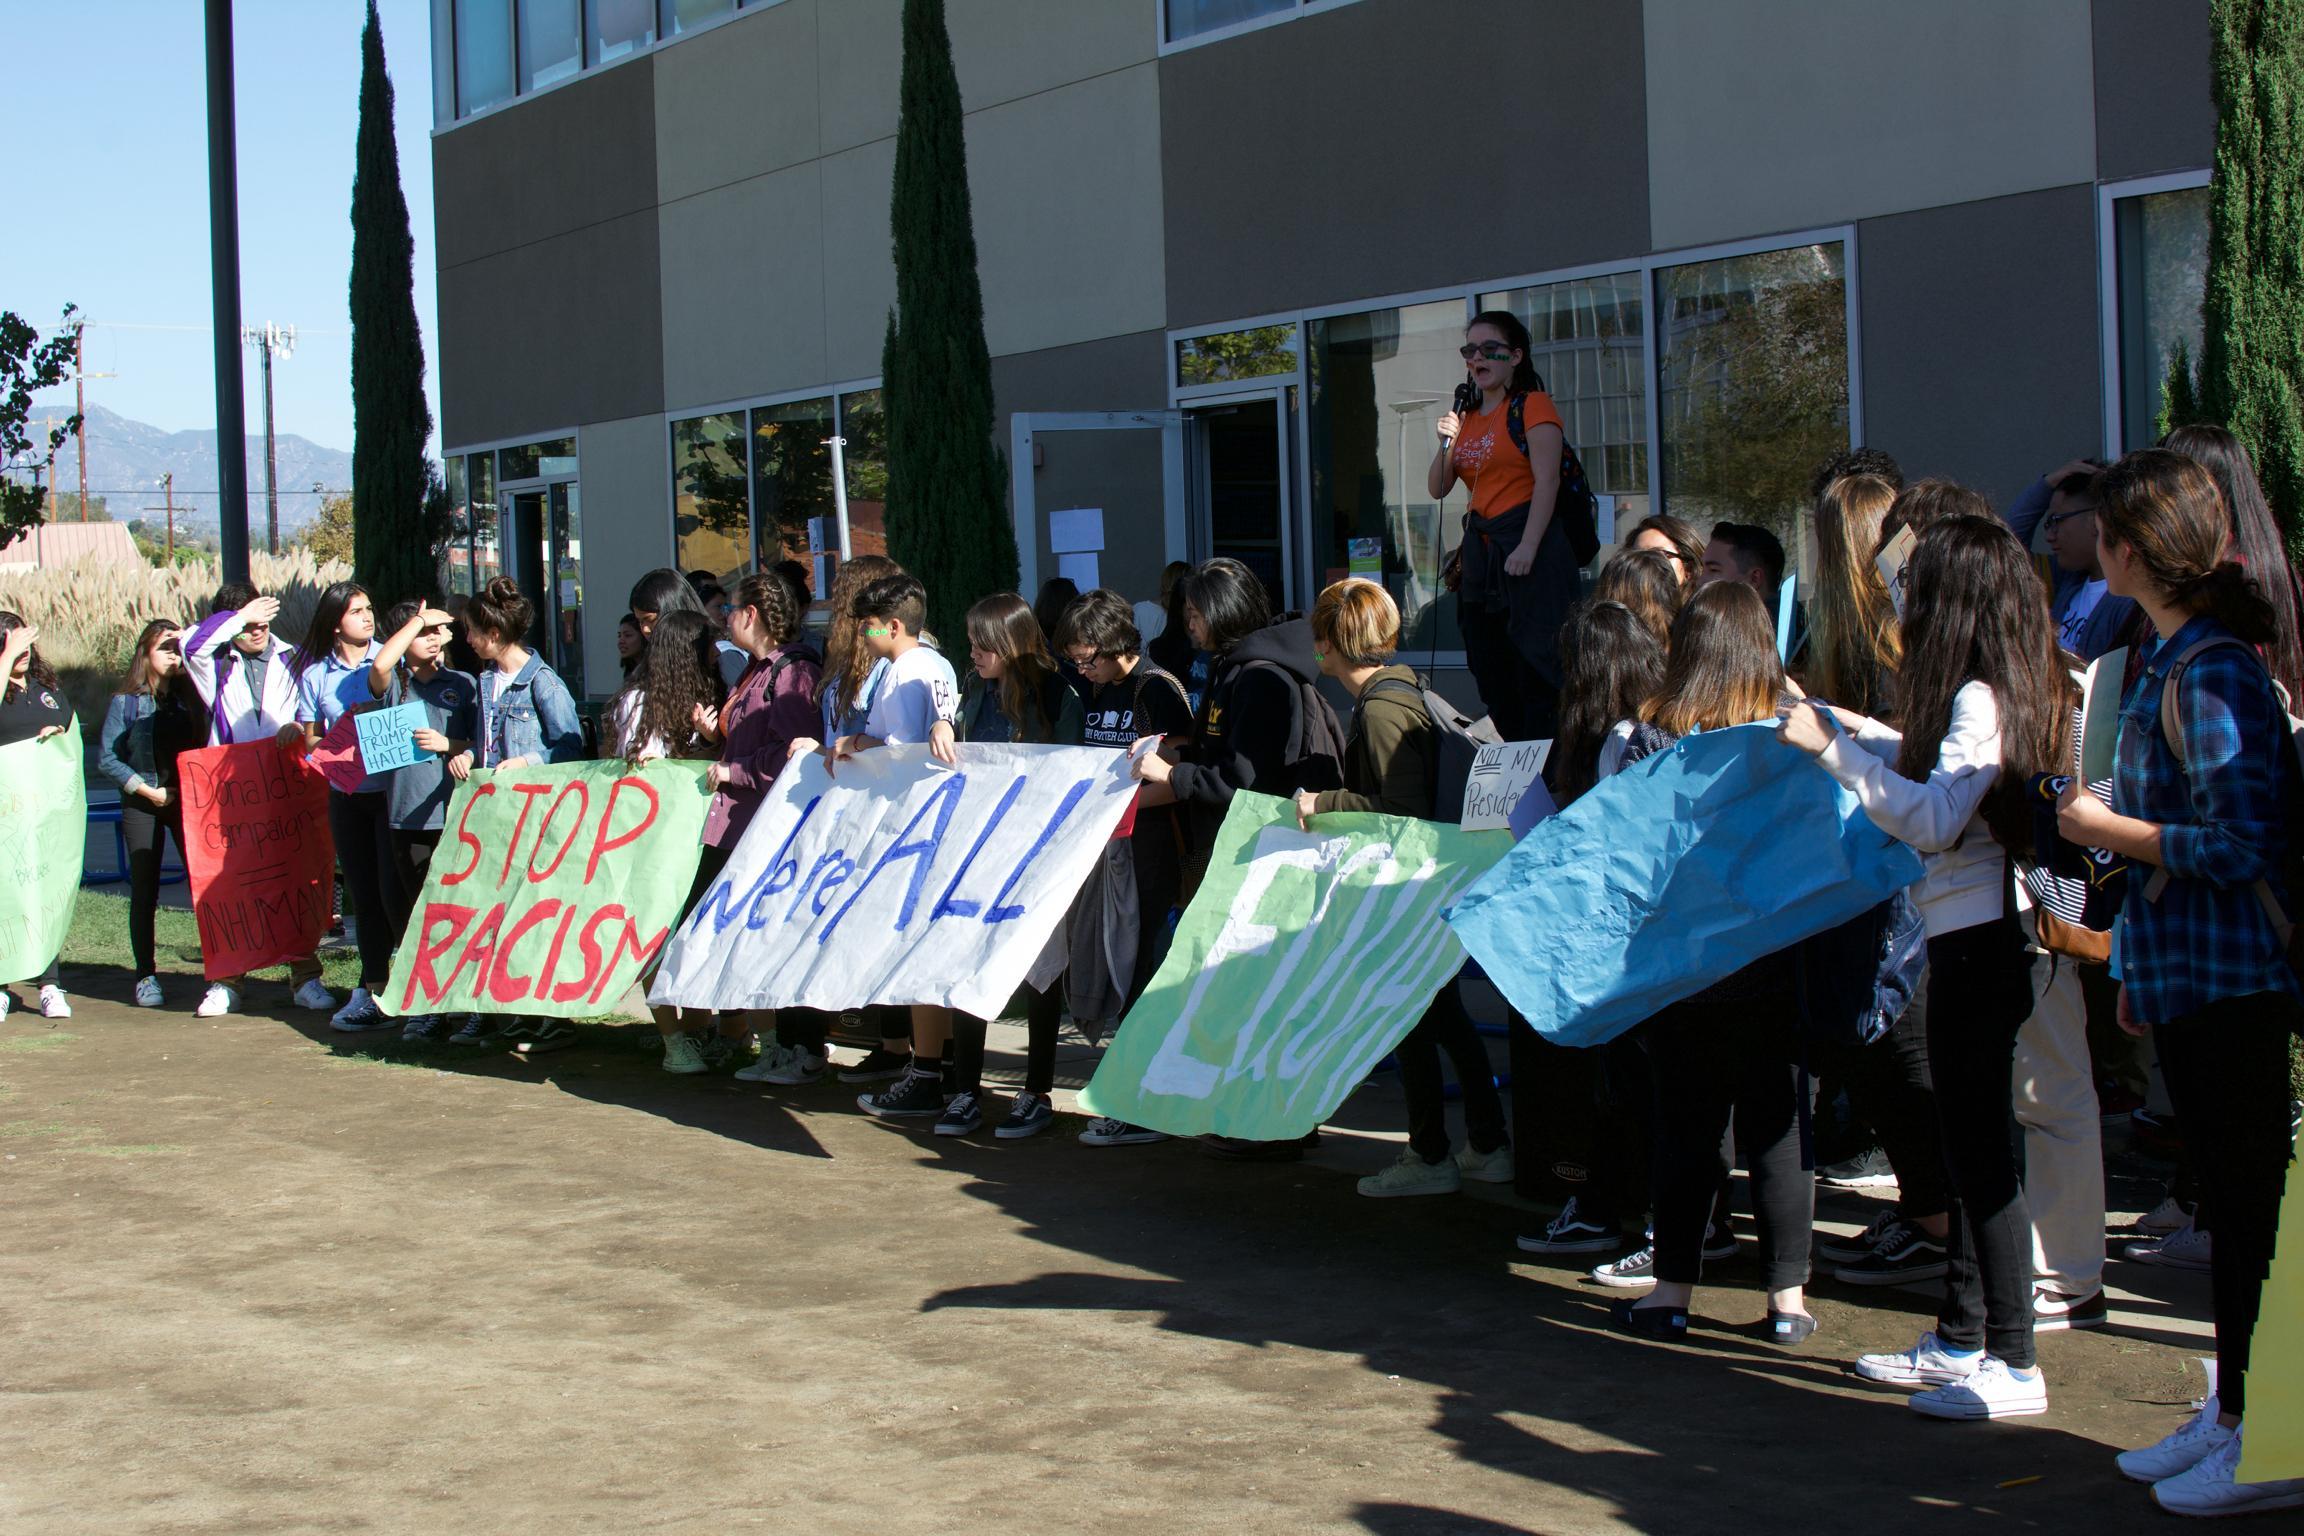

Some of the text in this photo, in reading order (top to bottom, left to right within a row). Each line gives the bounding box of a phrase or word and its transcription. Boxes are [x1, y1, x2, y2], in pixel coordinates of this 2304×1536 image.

[356, 708, 409, 740] LOVE
[1093, 730, 1117, 742] POTTER
[367, 745, 411, 770] HATE
[1475, 745, 1541, 773] NOT MY
[1468, 780, 1529, 818] Preside
[204, 808, 314, 859] campaign
[440, 776, 660, 891] STOP
[819, 772, 1096, 945] ALL
[200, 868, 330, 954] INHUMAN
[401, 898, 671, 1010] RACISM
[1556, 1165, 1587, 1179] KUSTOM
